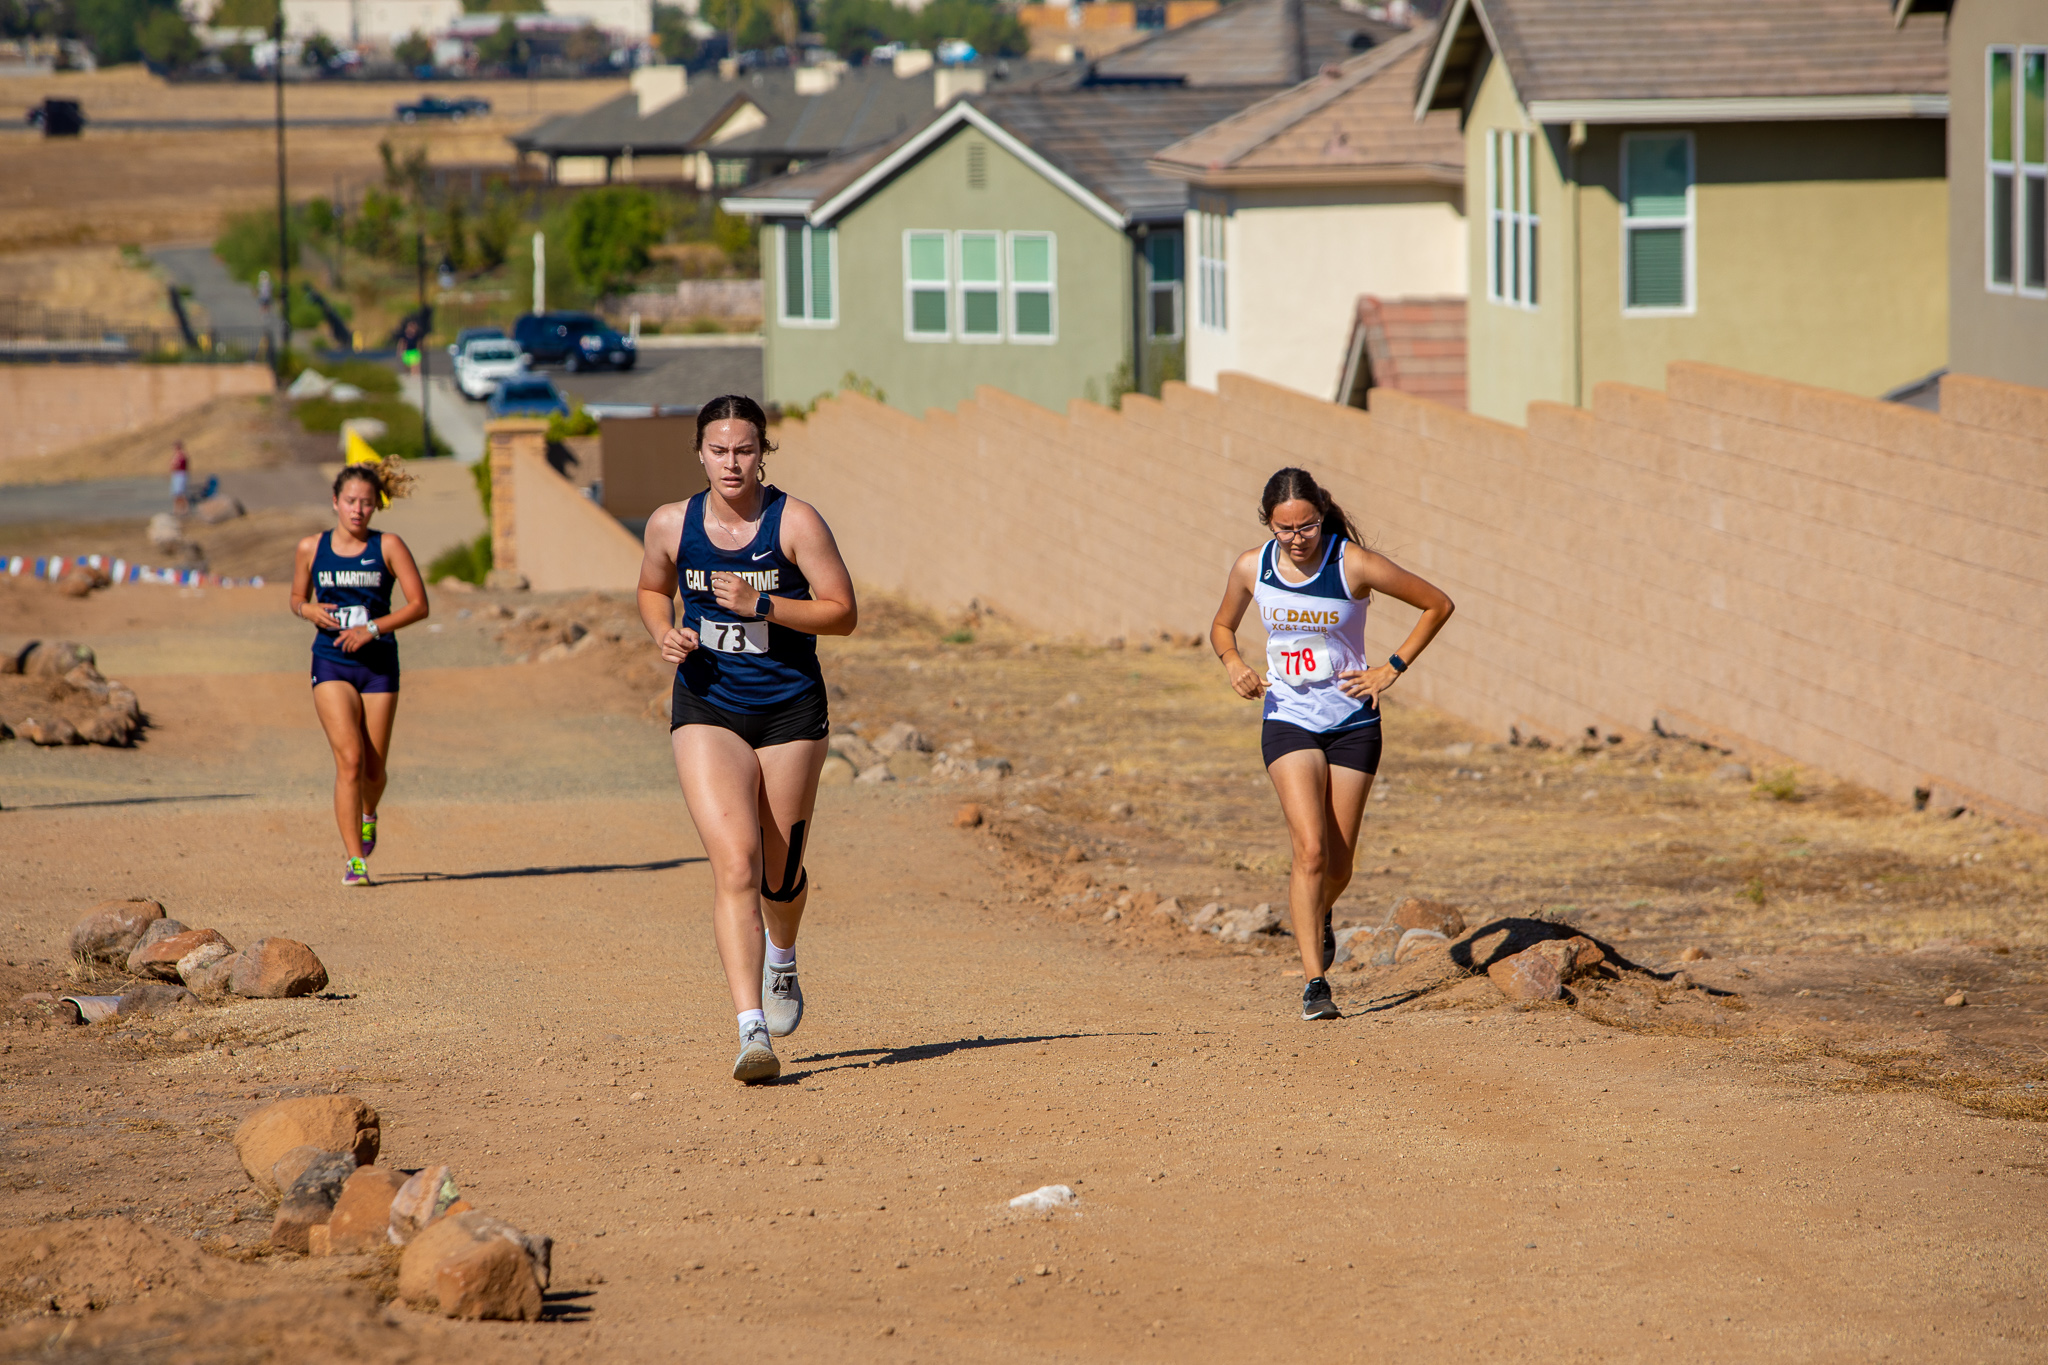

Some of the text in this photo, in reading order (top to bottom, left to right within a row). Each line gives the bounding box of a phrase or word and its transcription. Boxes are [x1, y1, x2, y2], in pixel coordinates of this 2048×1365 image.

[318, 571, 381, 587] CAL MARITIME
[686, 569, 708, 591] CAL
[715, 624, 746, 651] 73
[1272, 623, 1328, 633] XC&T CLUB
[1281, 648, 1316, 675] 778
